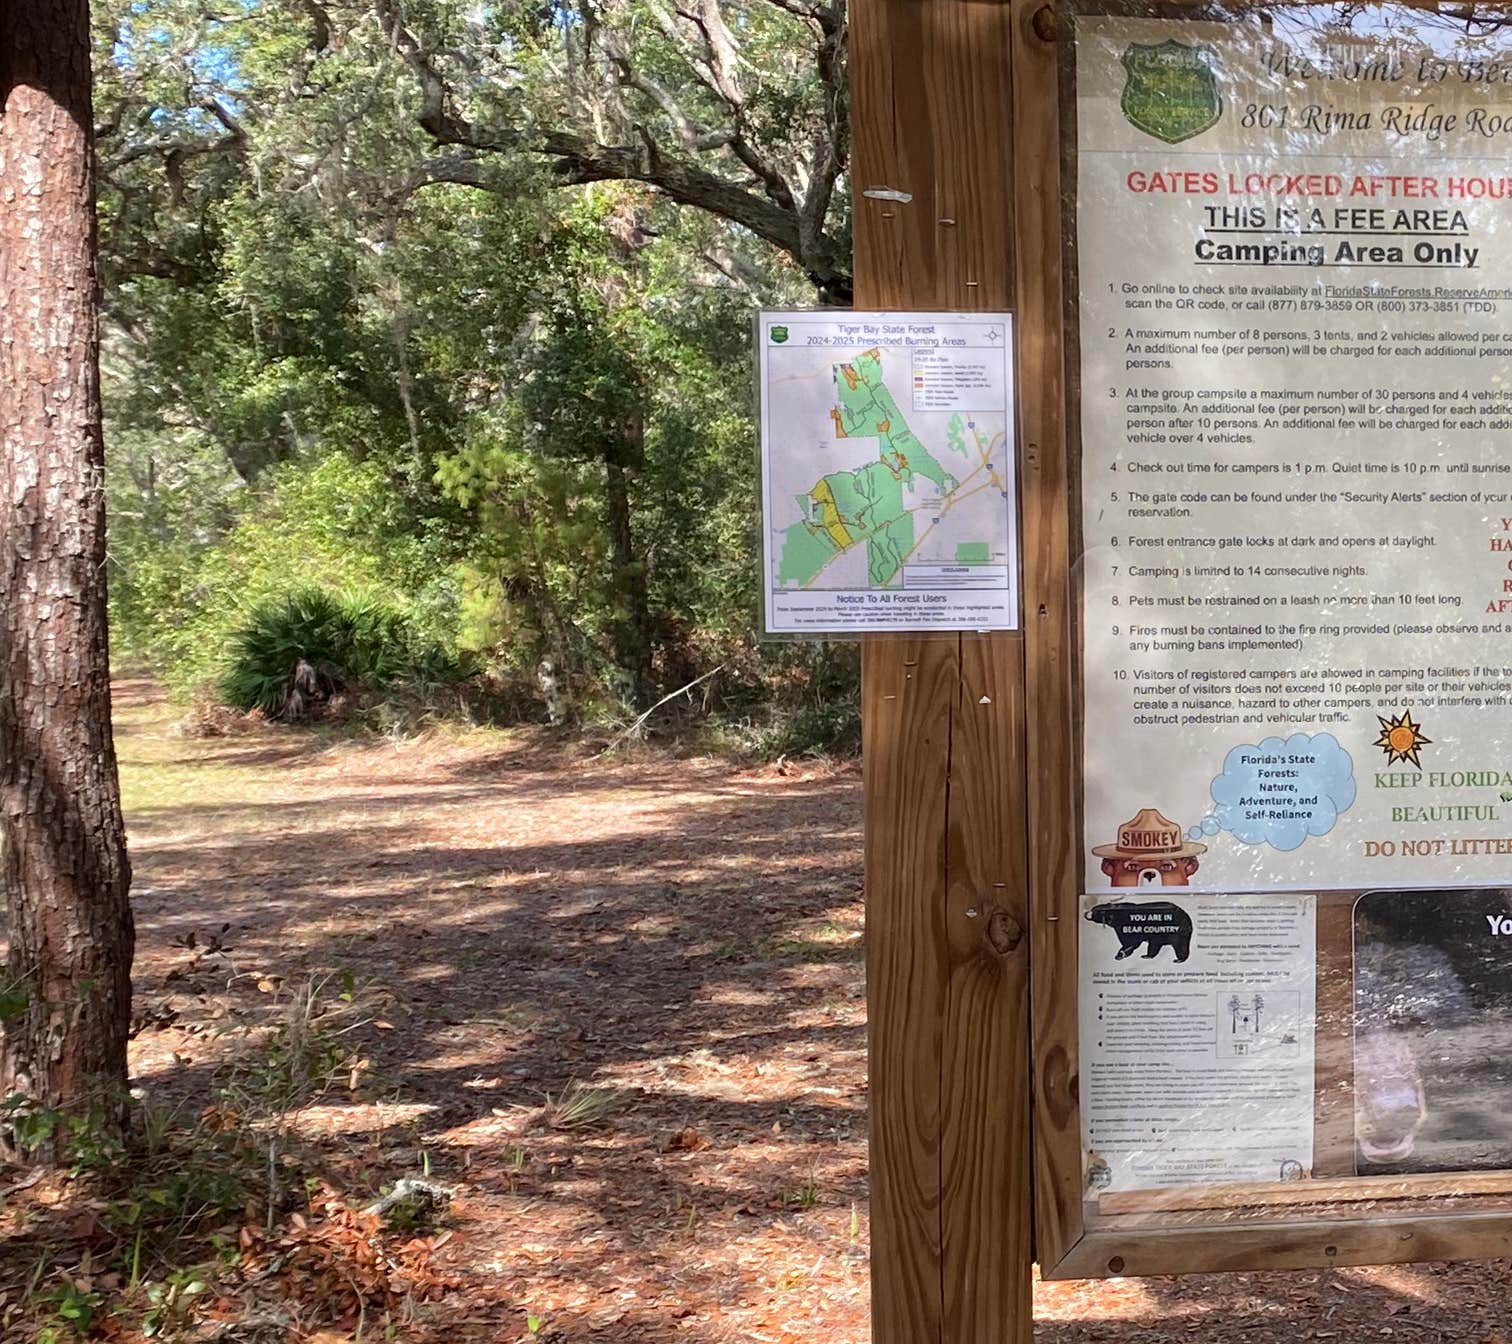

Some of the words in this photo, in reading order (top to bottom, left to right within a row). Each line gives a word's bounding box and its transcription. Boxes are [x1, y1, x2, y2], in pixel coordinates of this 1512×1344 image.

[1417, 57, 1447, 82] to
[1242, 104, 1288, 129] 801
[1301, 106, 1371, 134] Rima
[1381, 105, 1456, 141] Ridge
[1127, 172, 1219, 193] GATES
[1229, 174, 1342, 196] LOCKED
[1350, 175, 1438, 198] AFTER
[1204, 206, 1266, 228] THIS
[1276, 207, 1299, 229] IS
[1307, 208, 1326, 229] A
[1334, 208, 1385, 230] FEE
[1393, 210, 1469, 230] AREA
[1195, 239, 1324, 266] Camping
[1334, 241, 1403, 262] Area
[1414, 242, 1479, 268] Only
[838, 324, 861, 335] Tiger
[863, 324, 880, 335] Bay
[881, 324, 905, 334] State
[907, 324, 935, 334] Forest
[856, 336, 902, 346] Prescribed
[905, 336, 939, 347] Burning
[942, 336, 966, 346] Areas
[1126, 432, 1166, 443] vehicle
[1168, 434, 1193, 443] over
[1196, 432, 1203, 442] 4
[1206, 432, 1255, 443] vehicles.
[1127, 535, 1164, 547] Forest
[1166, 536, 1216, 547] entrance
[1218, 537, 1243, 549] gate
[1245, 535, 1274, 547] locks
[1277, 536, 1289, 547] at
[1290, 535, 1315, 546] dark
[1318, 535, 1339, 546] and
[1341, 537, 1376, 548] opens
[1378, 535, 1389, 546] at
[1392, 535, 1437, 548] daylight.
[1128, 565, 1179, 578] Camping
[1233, 566, 1244, 576] to
[1246, 565, 1261, 576] 14
[1263, 565, 1329, 576] consecutive
[1332, 565, 1367, 578] nights.
[836, 594, 864, 603] Notice
[866, 594, 878, 603] To
[879, 594, 891, 603] All
[892, 594, 920, 603] Forest
[922, 594, 947, 603] Users
[1240, 754, 1286, 764] Florida's
[1287, 754, 1315, 764] State
[1257, 768, 1299, 778] Forests:
[1374, 772, 1422, 788] KEEP
[1259, 782, 1298, 793] Nature,
[1238, 796, 1296, 807] Adventure,
[1298, 795, 1318, 805] and
[1245, 809, 1312, 819] Self-Reliance
[1391, 805, 1499, 822] BEAUTIFUL
[1121, 830, 1179, 847] SMOKEY
[1364, 840, 1396, 857] DO
[1401, 839, 1445, 856] NOT
[1129, 913, 1148, 921] YOU
[1147, 913, 1162, 921] ARE
[1122, 925, 1143, 933] BEAR
[1143, 925, 1179, 933] COUNTRY
